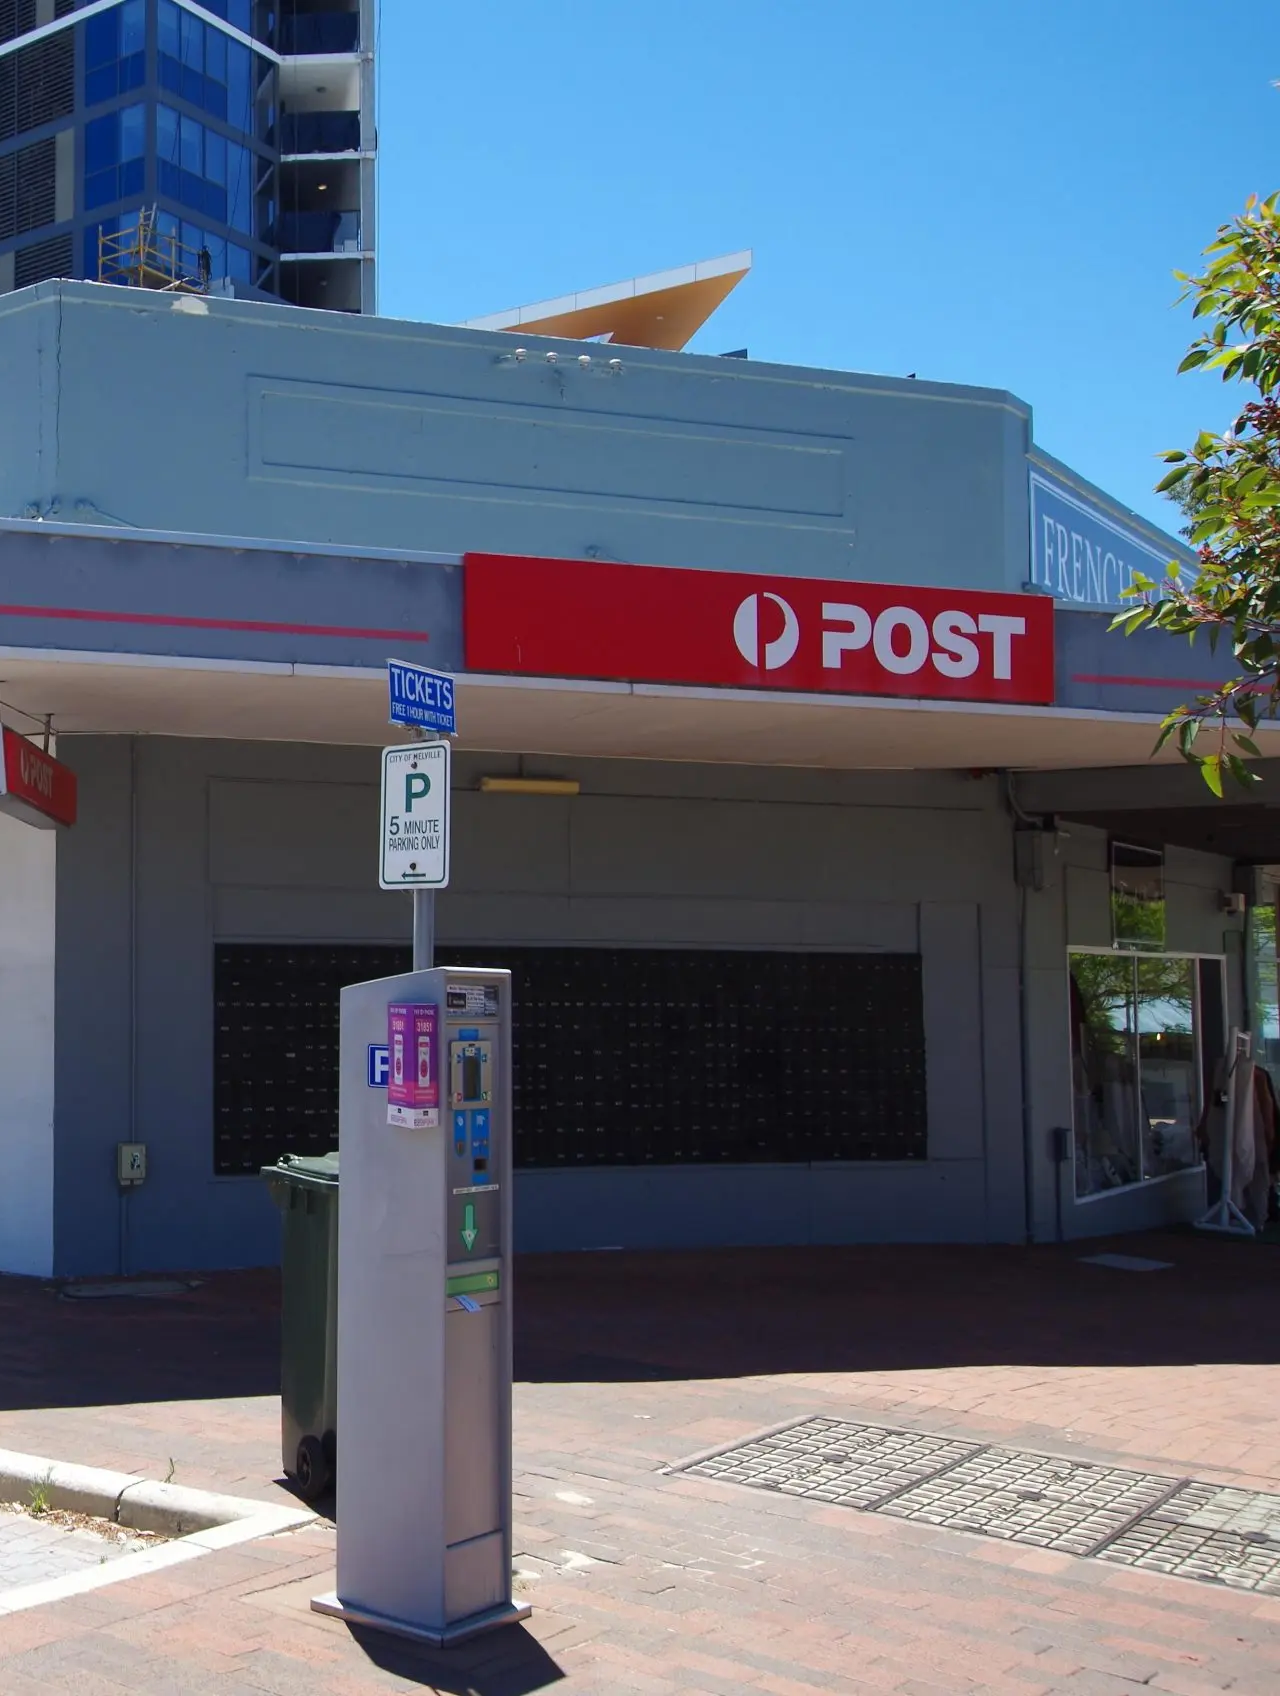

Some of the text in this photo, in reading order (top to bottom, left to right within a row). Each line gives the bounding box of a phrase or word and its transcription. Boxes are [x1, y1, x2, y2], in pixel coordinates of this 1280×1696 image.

[1042, 513, 1135, 605] FRENCH
[822, 602, 1026, 681] POST
[391, 667, 453, 710] TICKETS
[392, 702, 406, 717] FREE
[410, 706, 424, 721] HOUR
[424, 709, 437, 724] WITH
[437, 712, 453, 727] TICKET
[389, 750, 441, 763] CITY OF MELVILLE
[405, 772, 431, 813] P
[389, 815, 440, 835] 5 MINUTE
[389, 835, 440, 852] PARKING ONLY
